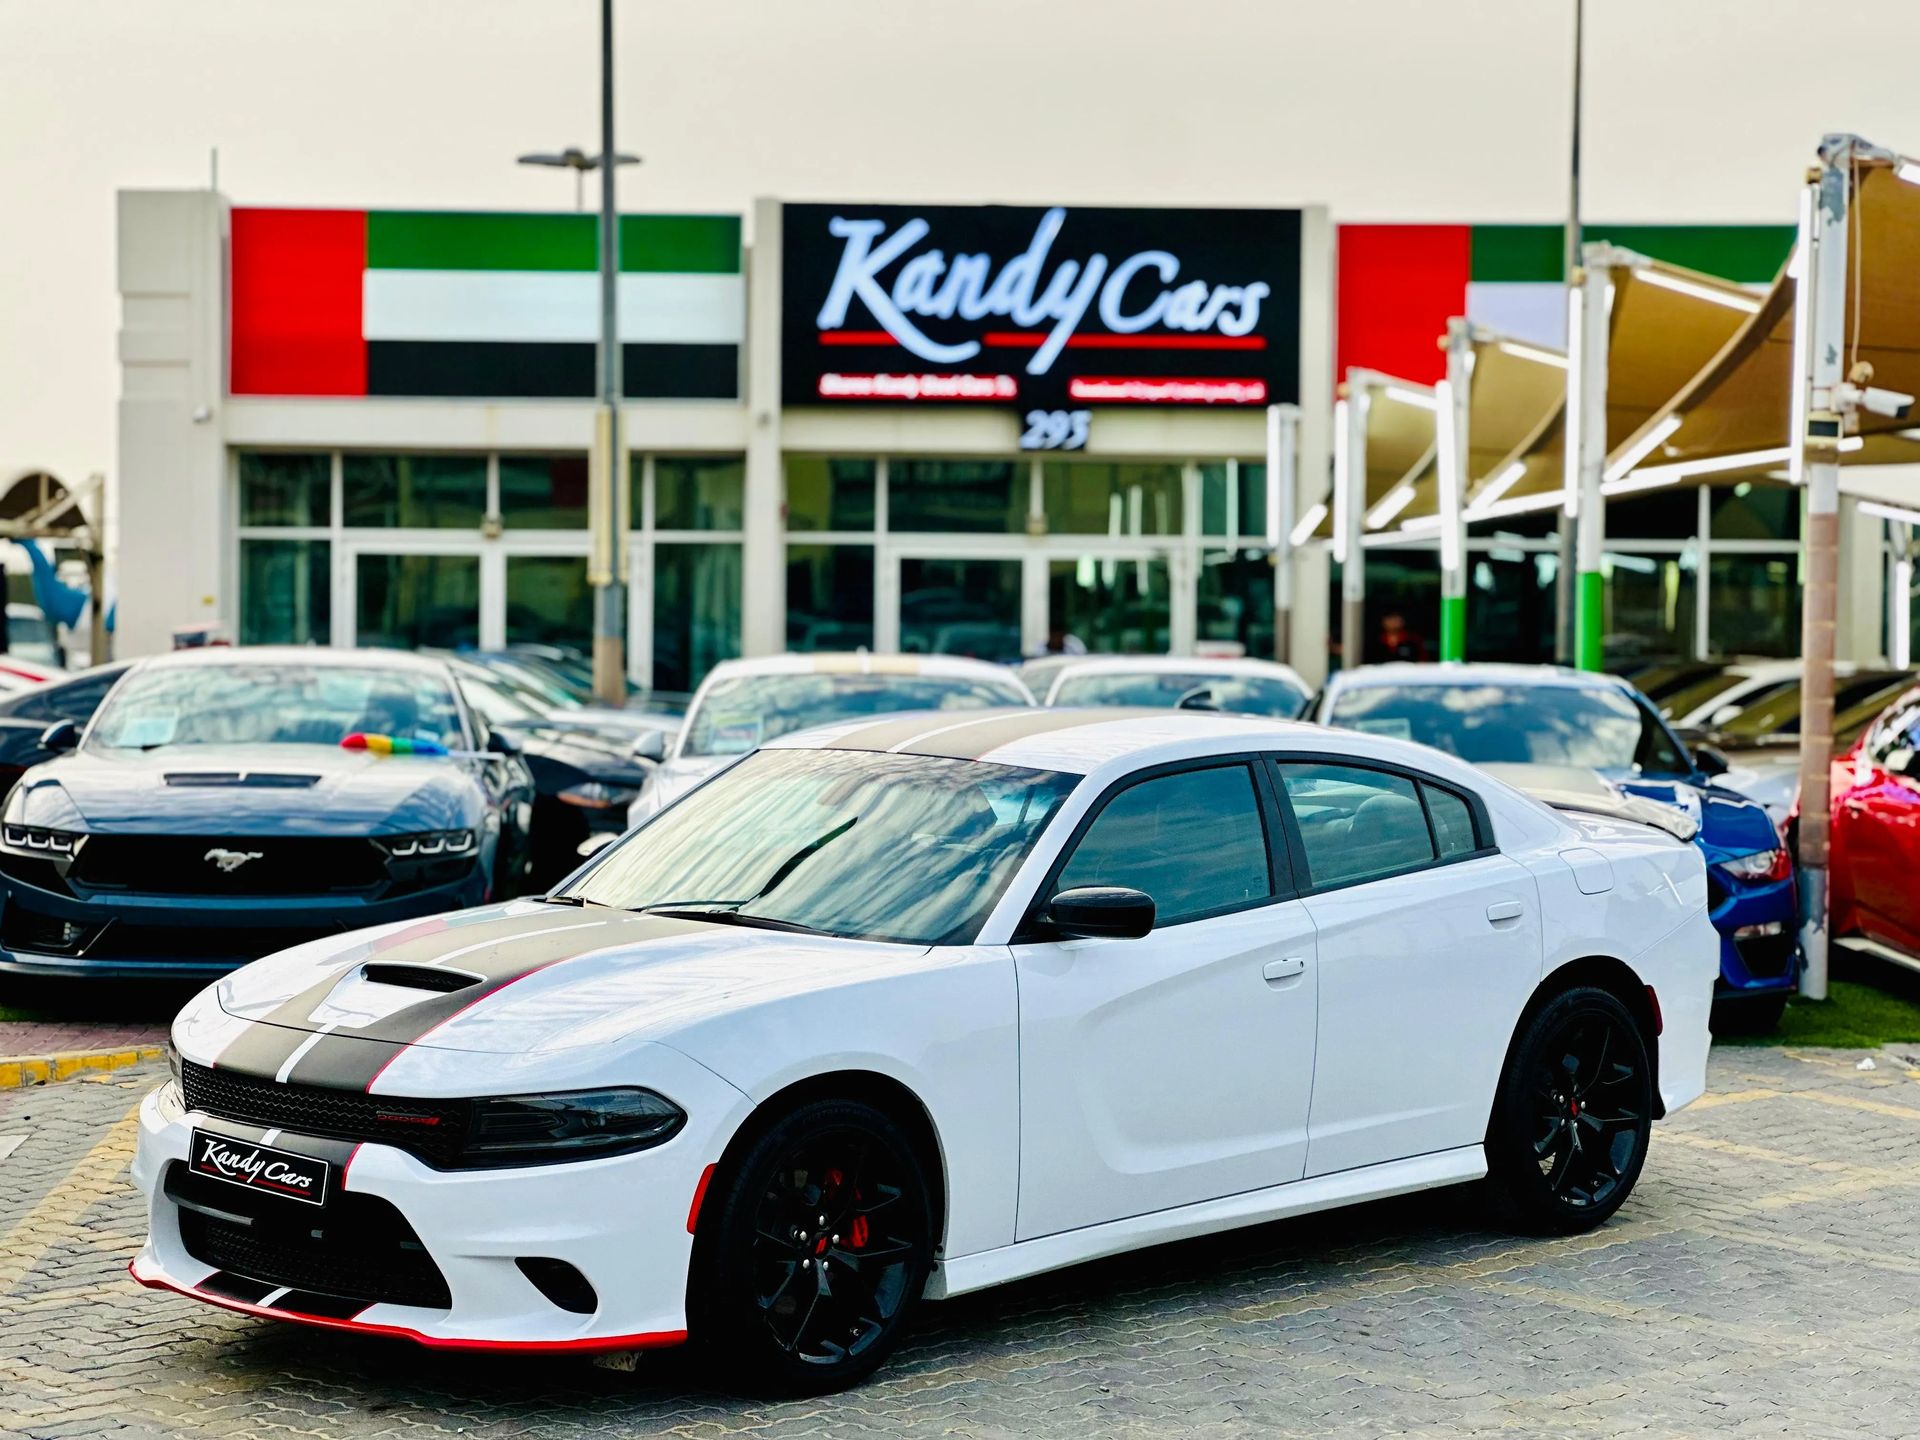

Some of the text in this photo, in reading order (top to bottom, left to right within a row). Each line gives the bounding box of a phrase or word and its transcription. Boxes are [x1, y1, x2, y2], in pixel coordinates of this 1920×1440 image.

[816, 206, 1270, 375] Kandy Cars
[1019, 409, 1092, 449] 295
[201, 1139, 313, 1188] Kandy Cars
